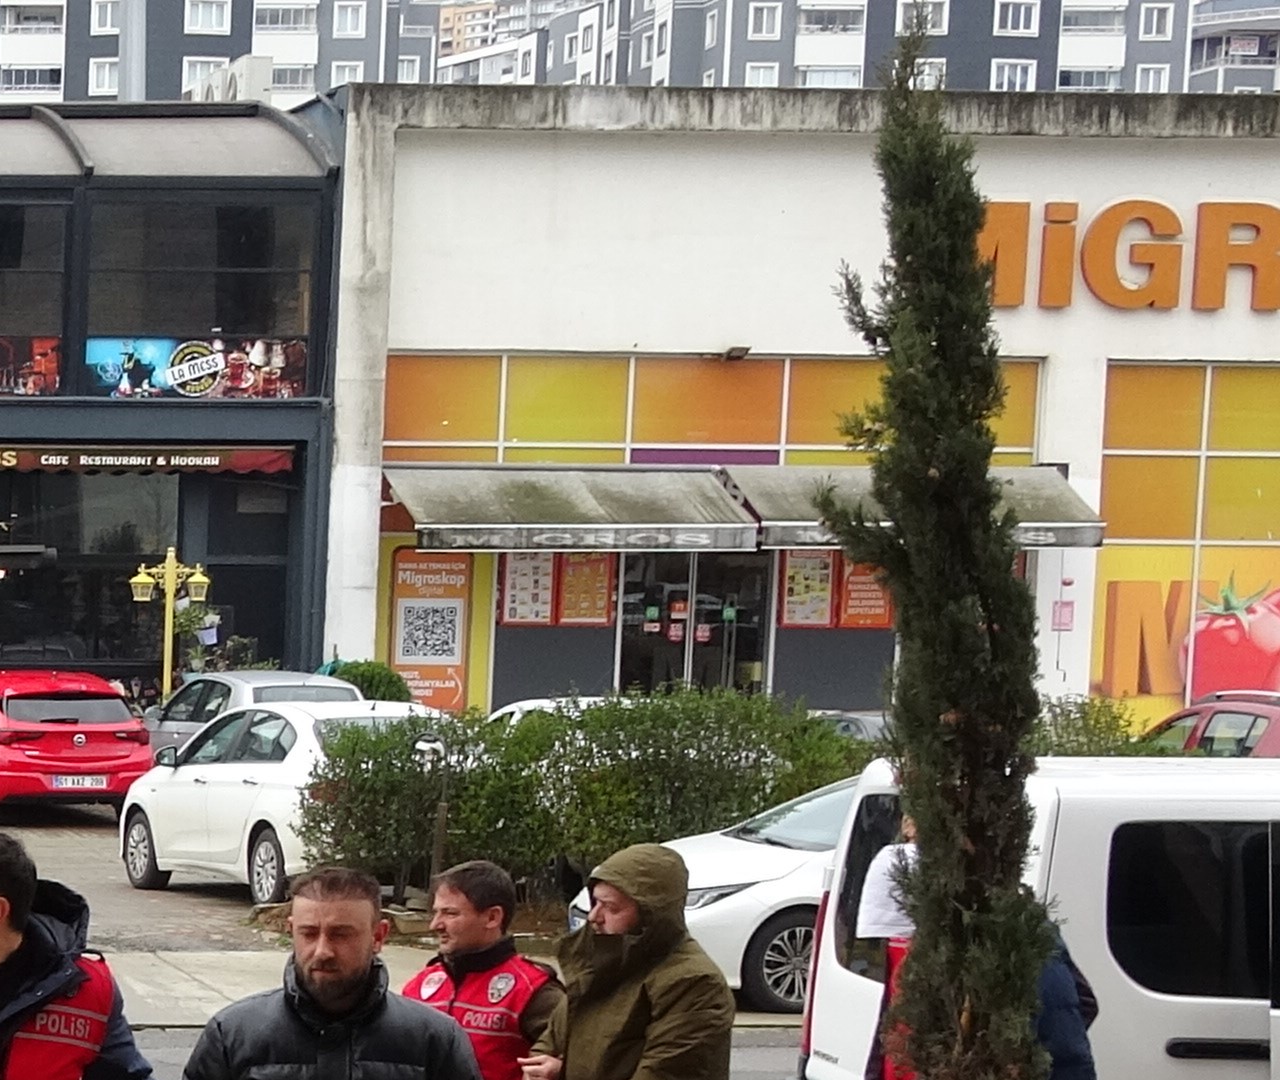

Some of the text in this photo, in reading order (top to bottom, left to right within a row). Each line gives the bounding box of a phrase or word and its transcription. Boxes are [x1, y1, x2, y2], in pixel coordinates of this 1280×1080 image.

[171, 357, 219, 381] LA MESS
[79, 455, 151, 466] RESTAURANT
[156, 455, 166, 465] &
[170, 455, 219, 466] HOOKAH
[398, 570, 465, 588] Migroskop
